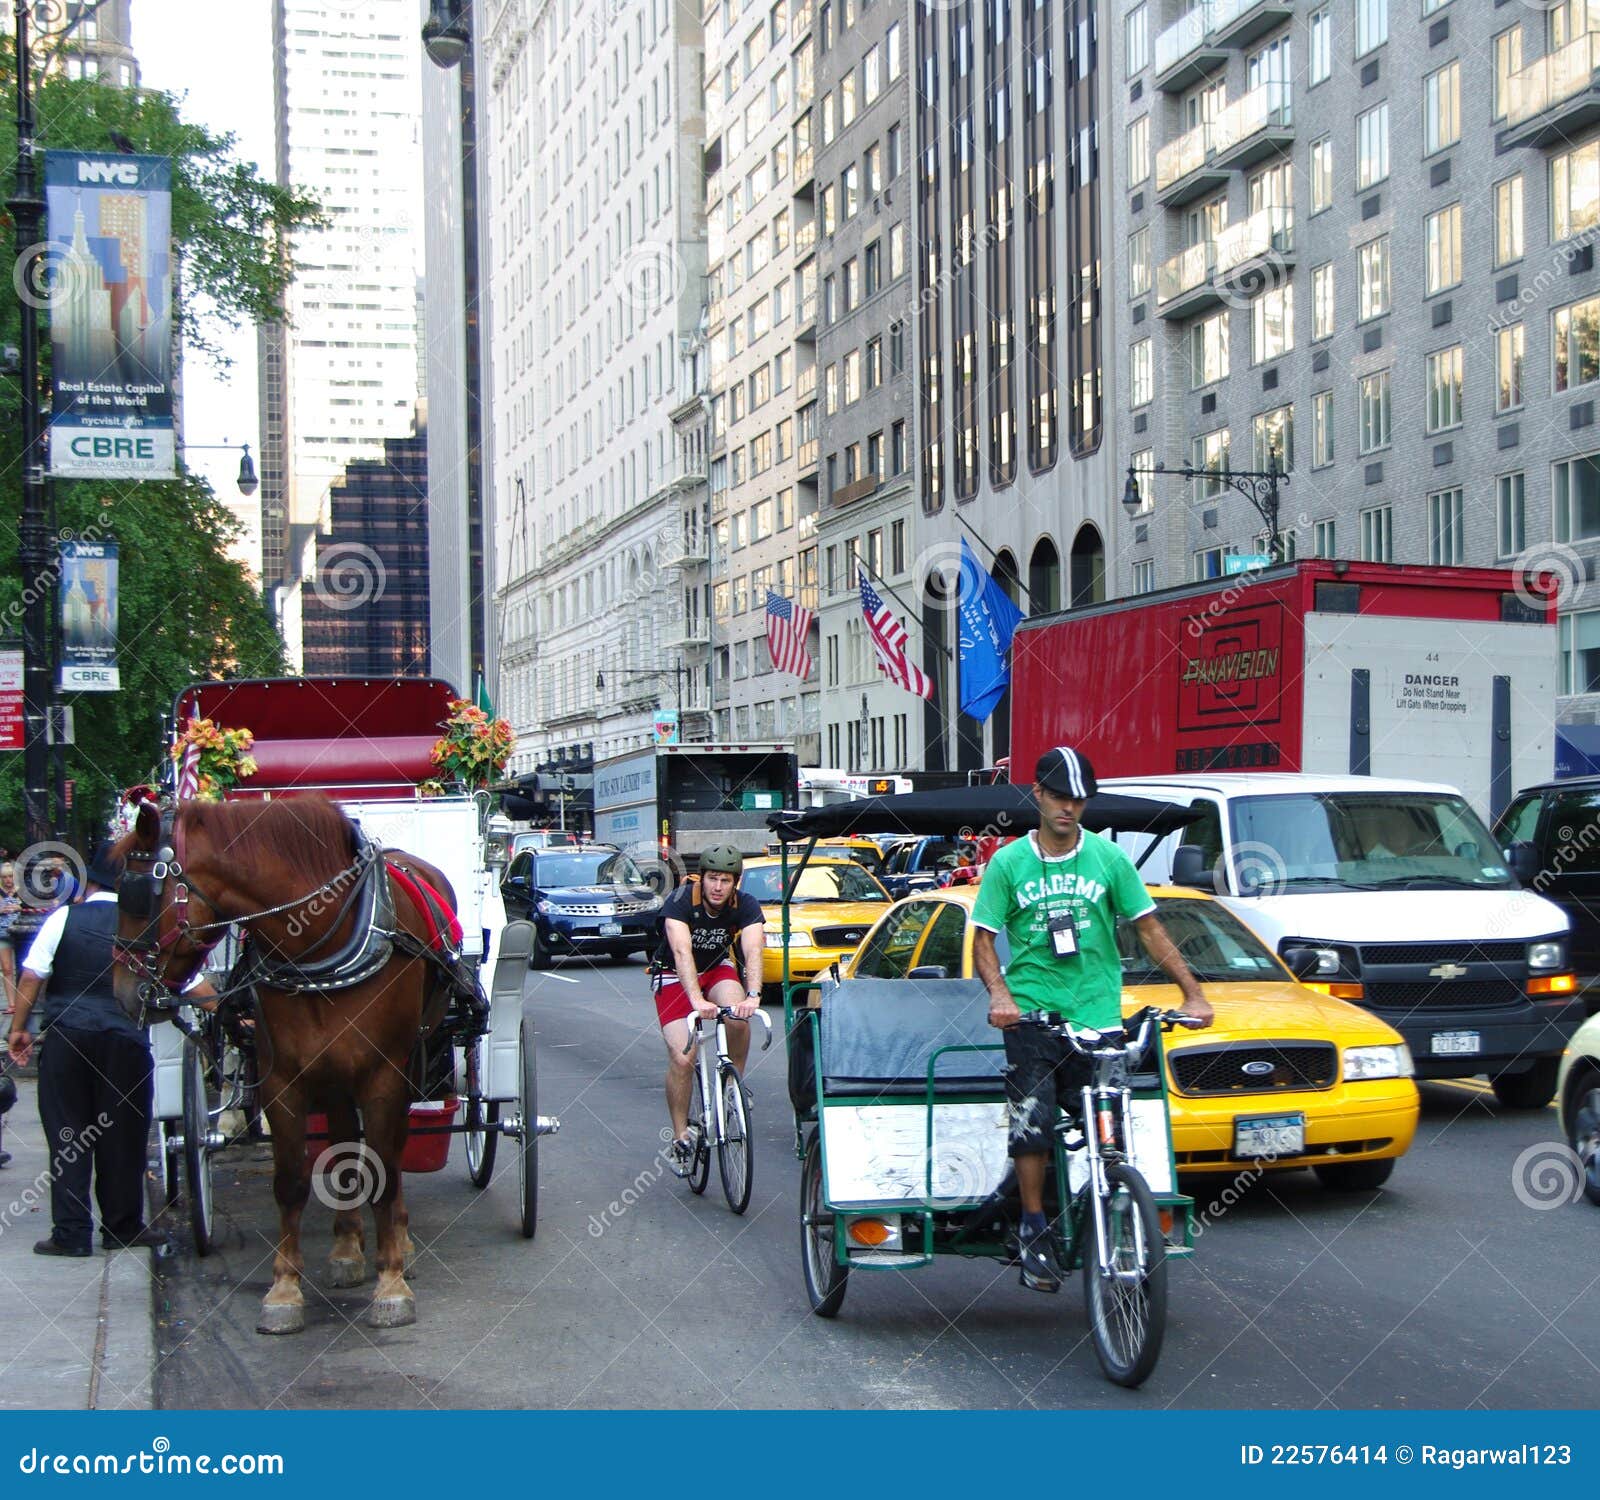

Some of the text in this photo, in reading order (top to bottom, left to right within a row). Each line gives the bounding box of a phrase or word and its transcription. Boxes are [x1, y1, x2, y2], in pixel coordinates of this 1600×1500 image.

[78, 161, 139, 184] NYC
[59, 381, 165, 395] Real Estate Capital
[77, 395, 147, 406] of the World
[70, 436, 155, 459] CBRE
[1425, 653, 1439, 662] 44
[1182, 648, 1278, 688] PANAVISION
[72, 671, 110, 681] CBRE
[1405, 674, 1459, 687] DANGER
[1403, 687, 1460, 699] Do Not Stand Near
[1396, 699, 1406, 708] Lift
[1423, 700, 1439, 710] When
[1440, 701, 1466, 714] Dropping
[1016, 873, 1106, 909] ACADEMY
